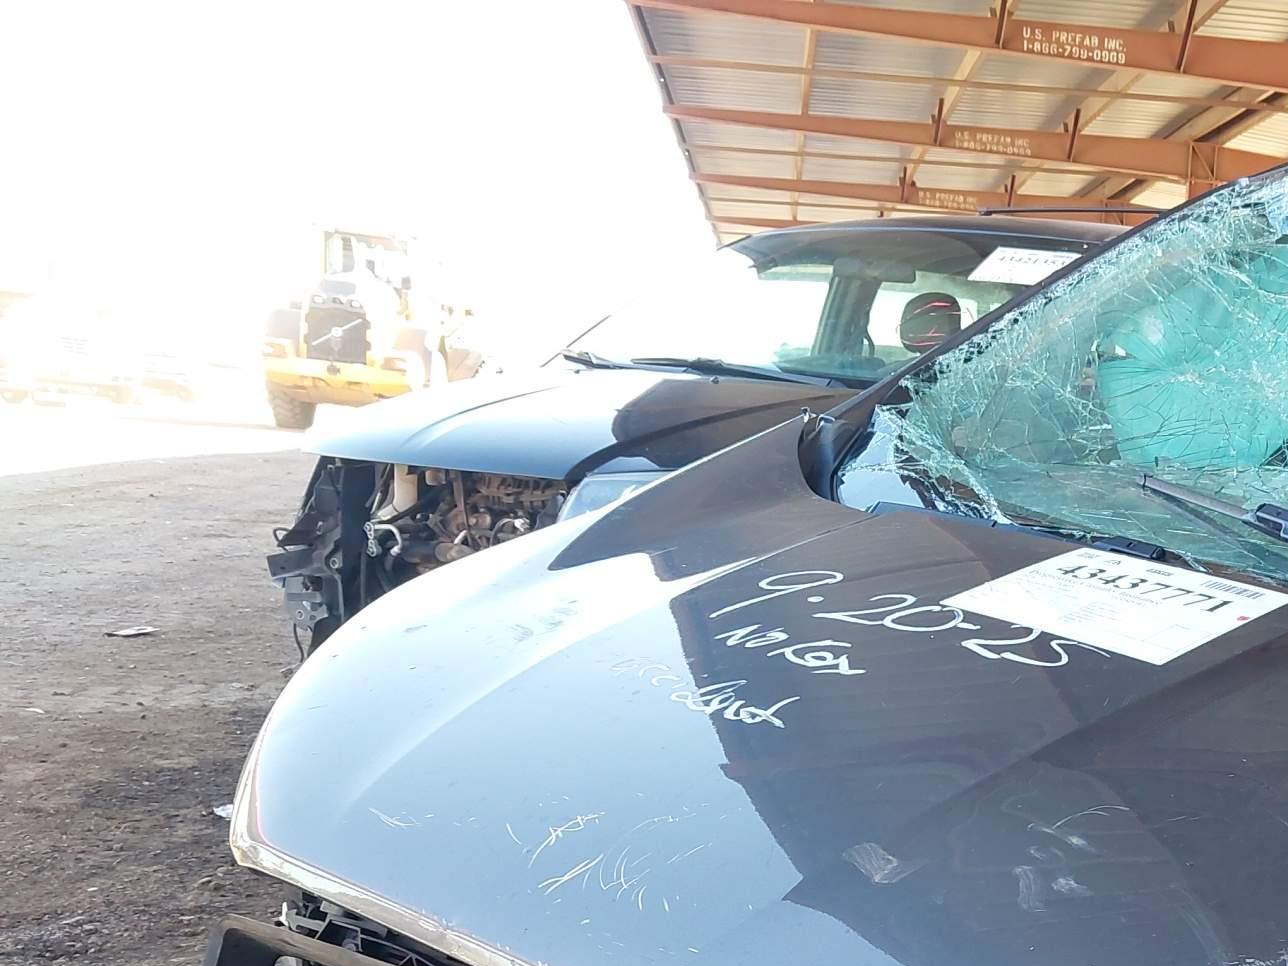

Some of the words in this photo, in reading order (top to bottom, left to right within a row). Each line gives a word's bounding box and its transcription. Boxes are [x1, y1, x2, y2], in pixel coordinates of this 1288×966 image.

[1022, 26, 1046, 41] U.S.
[1052, 30, 1099, 48] PREFAB
[1104, 37, 1127, 52] INC.
[1056, 564, 1234, 613] 43437771
